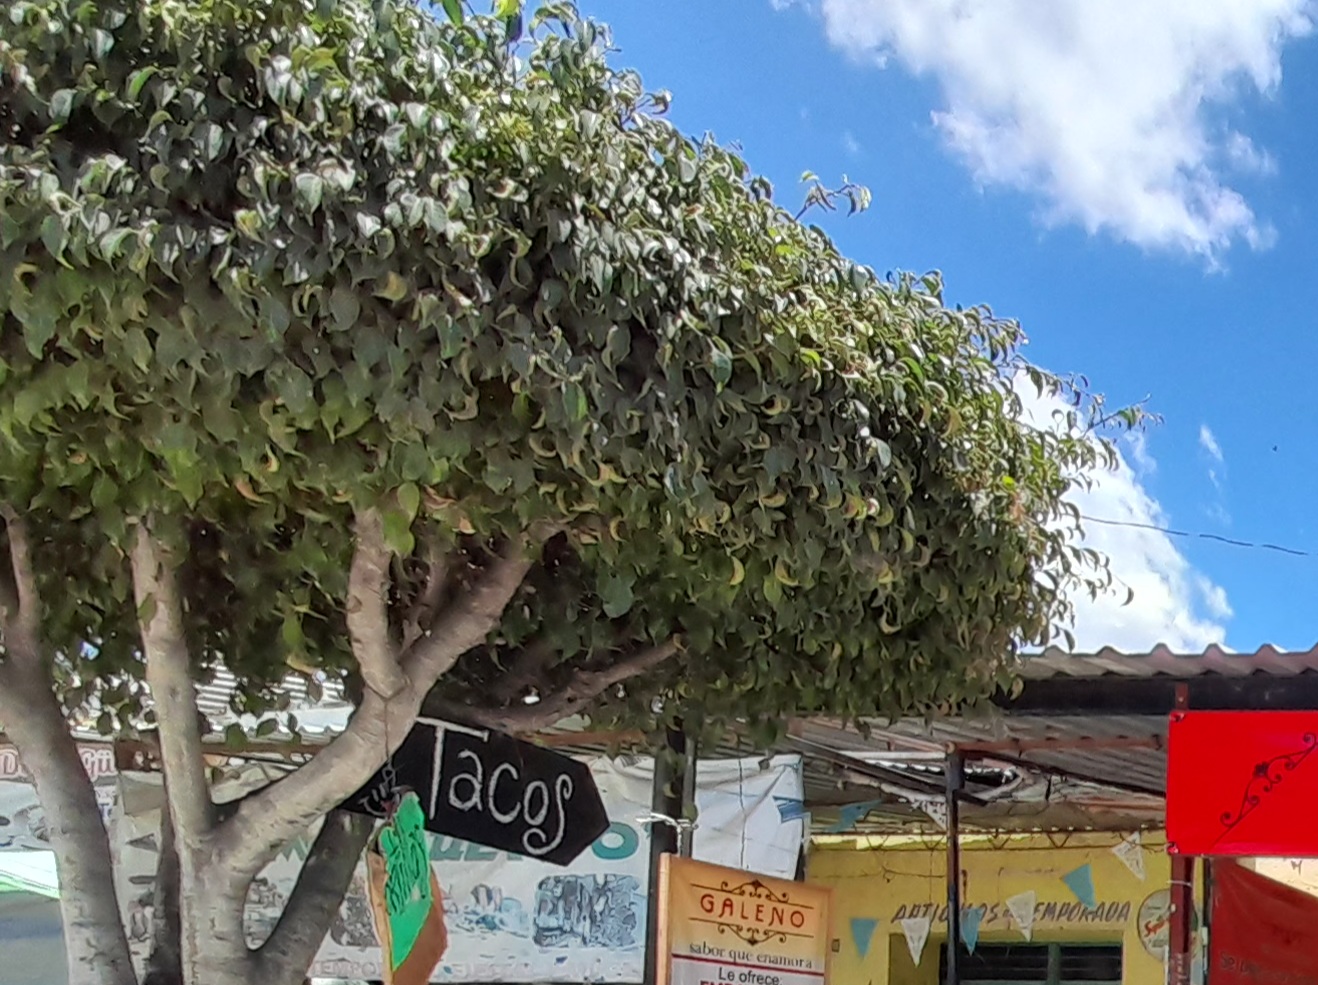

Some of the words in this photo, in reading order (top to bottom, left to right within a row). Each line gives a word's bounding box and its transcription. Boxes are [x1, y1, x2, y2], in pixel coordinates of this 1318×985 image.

[416, 716, 573, 855] Tacos
[700, 893, 805, 929] GALENO
[1034, 901, 1131, 922] EMPORADA
[690, 941, 726, 957] sabor
[728, 949, 753, 965] que
[756, 953, 813, 969] enamora
[718, 967, 735, 981] Le
